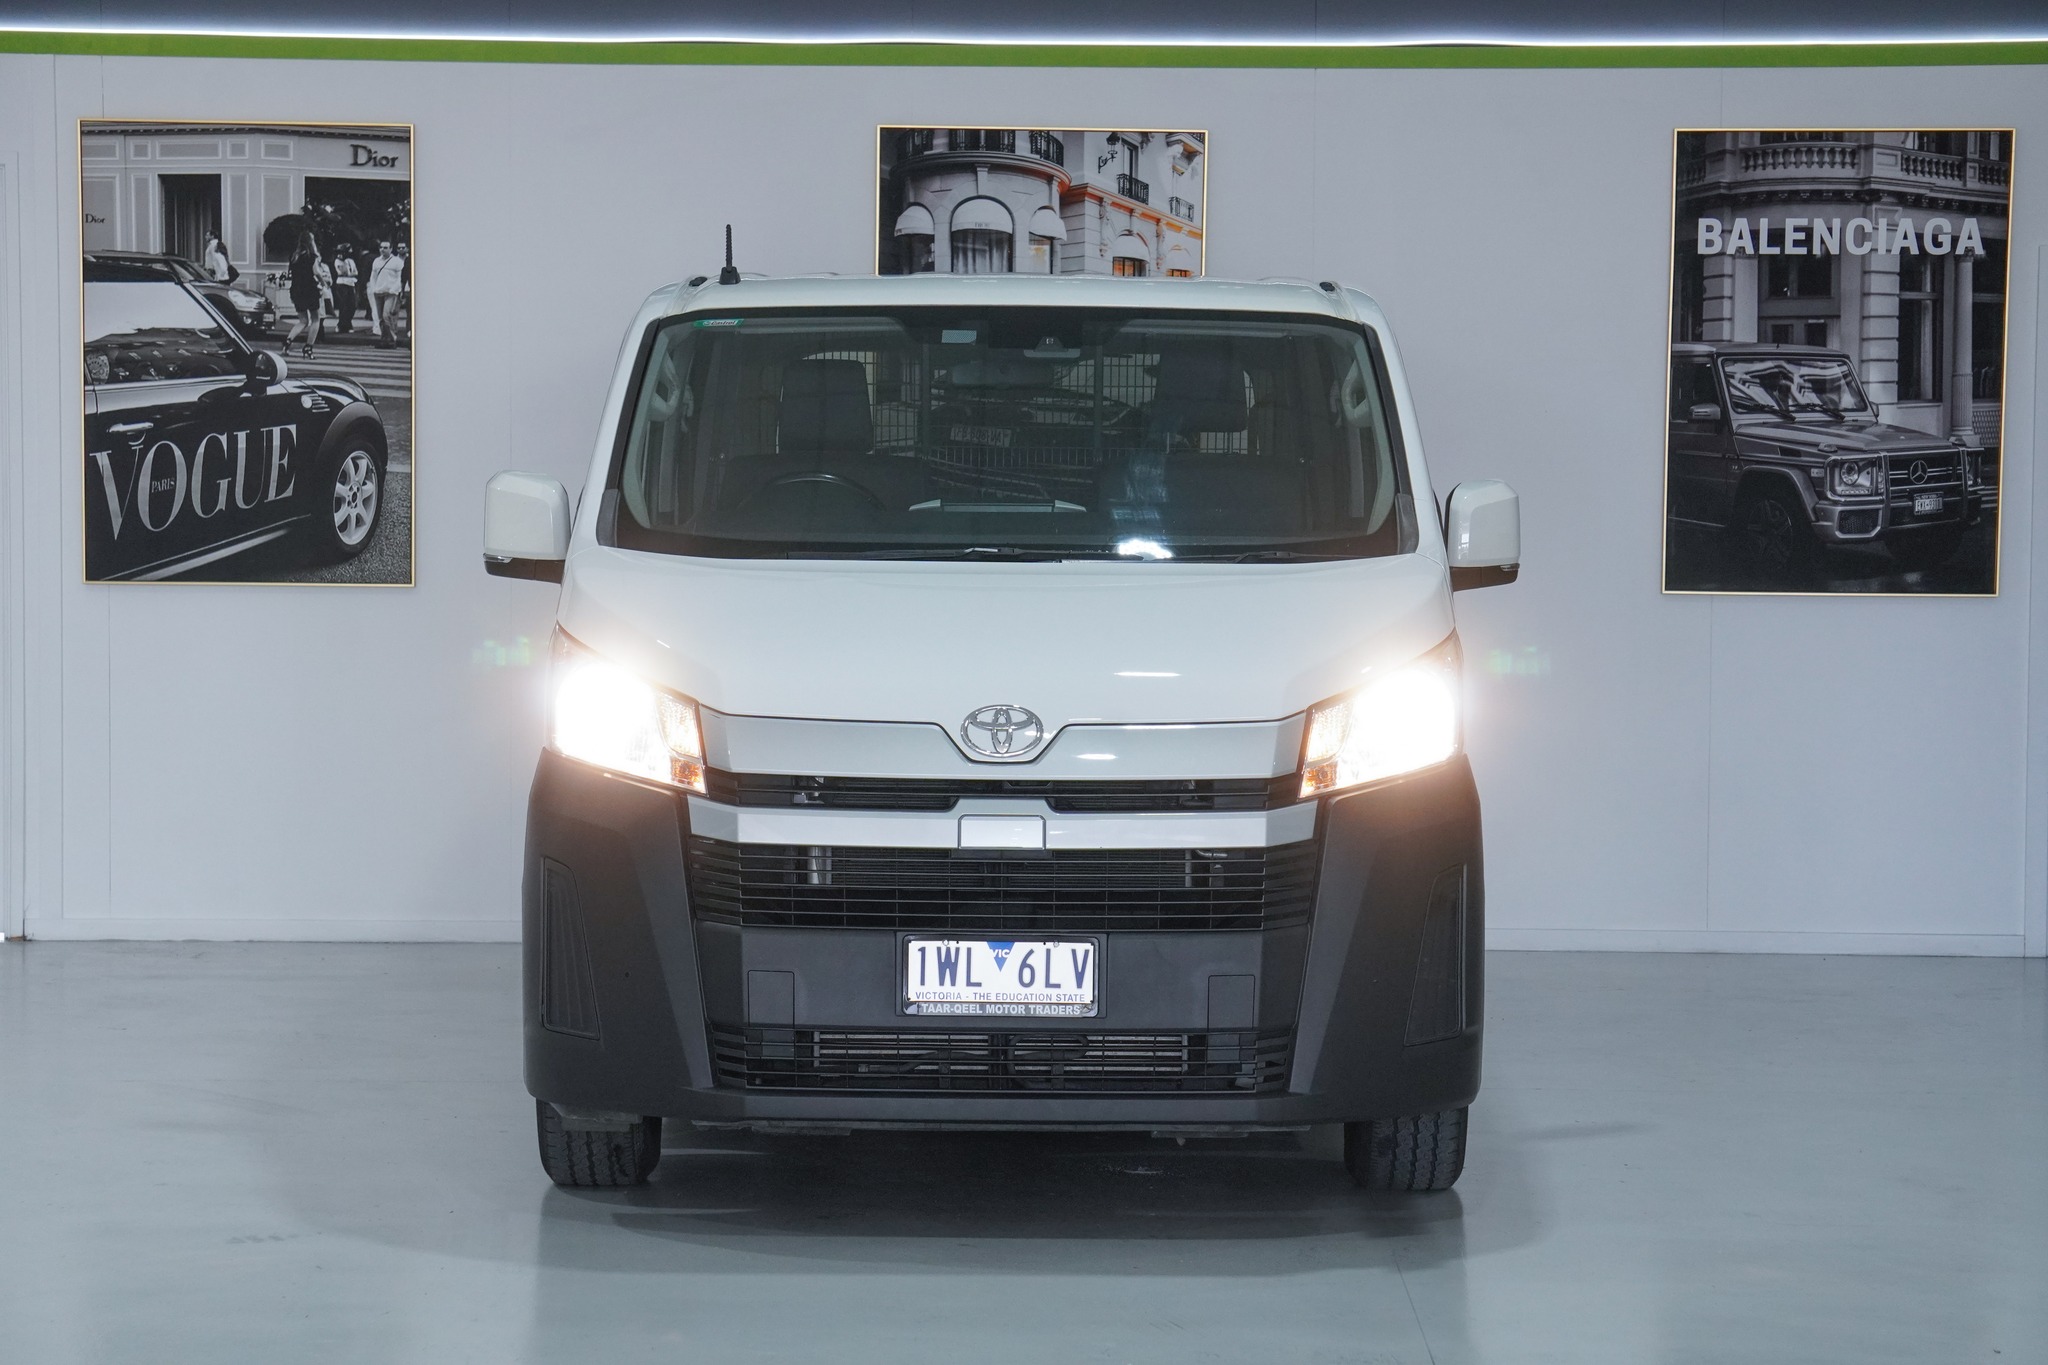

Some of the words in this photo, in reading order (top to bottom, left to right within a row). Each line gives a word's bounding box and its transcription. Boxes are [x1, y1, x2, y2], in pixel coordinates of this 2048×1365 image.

[349, 143, 399, 168] Dior
[85, 213, 106, 224] Dior
[1696, 216, 1985, 256] BALENCIAGA
[89, 423, 298, 541] VOGUE
[151, 477, 175, 493] PARIS
[991, 948, 1010, 958] VIC
[917, 946, 983, 987] 1WL
[1018, 947, 1090, 989] 6LV
[915, 991, 962, 1000] VICTORIA
[973, 992, 992, 1001] THE
[995, 992, 1053, 1001] EDUCATION
[1056, 993, 1085, 1002] STATE
[922, 1003, 983, 1014] TAAR-QEEL
[985, 1003, 1026, 1015] MOTOR
[1028, 1004, 1081, 1015] TRADERS
